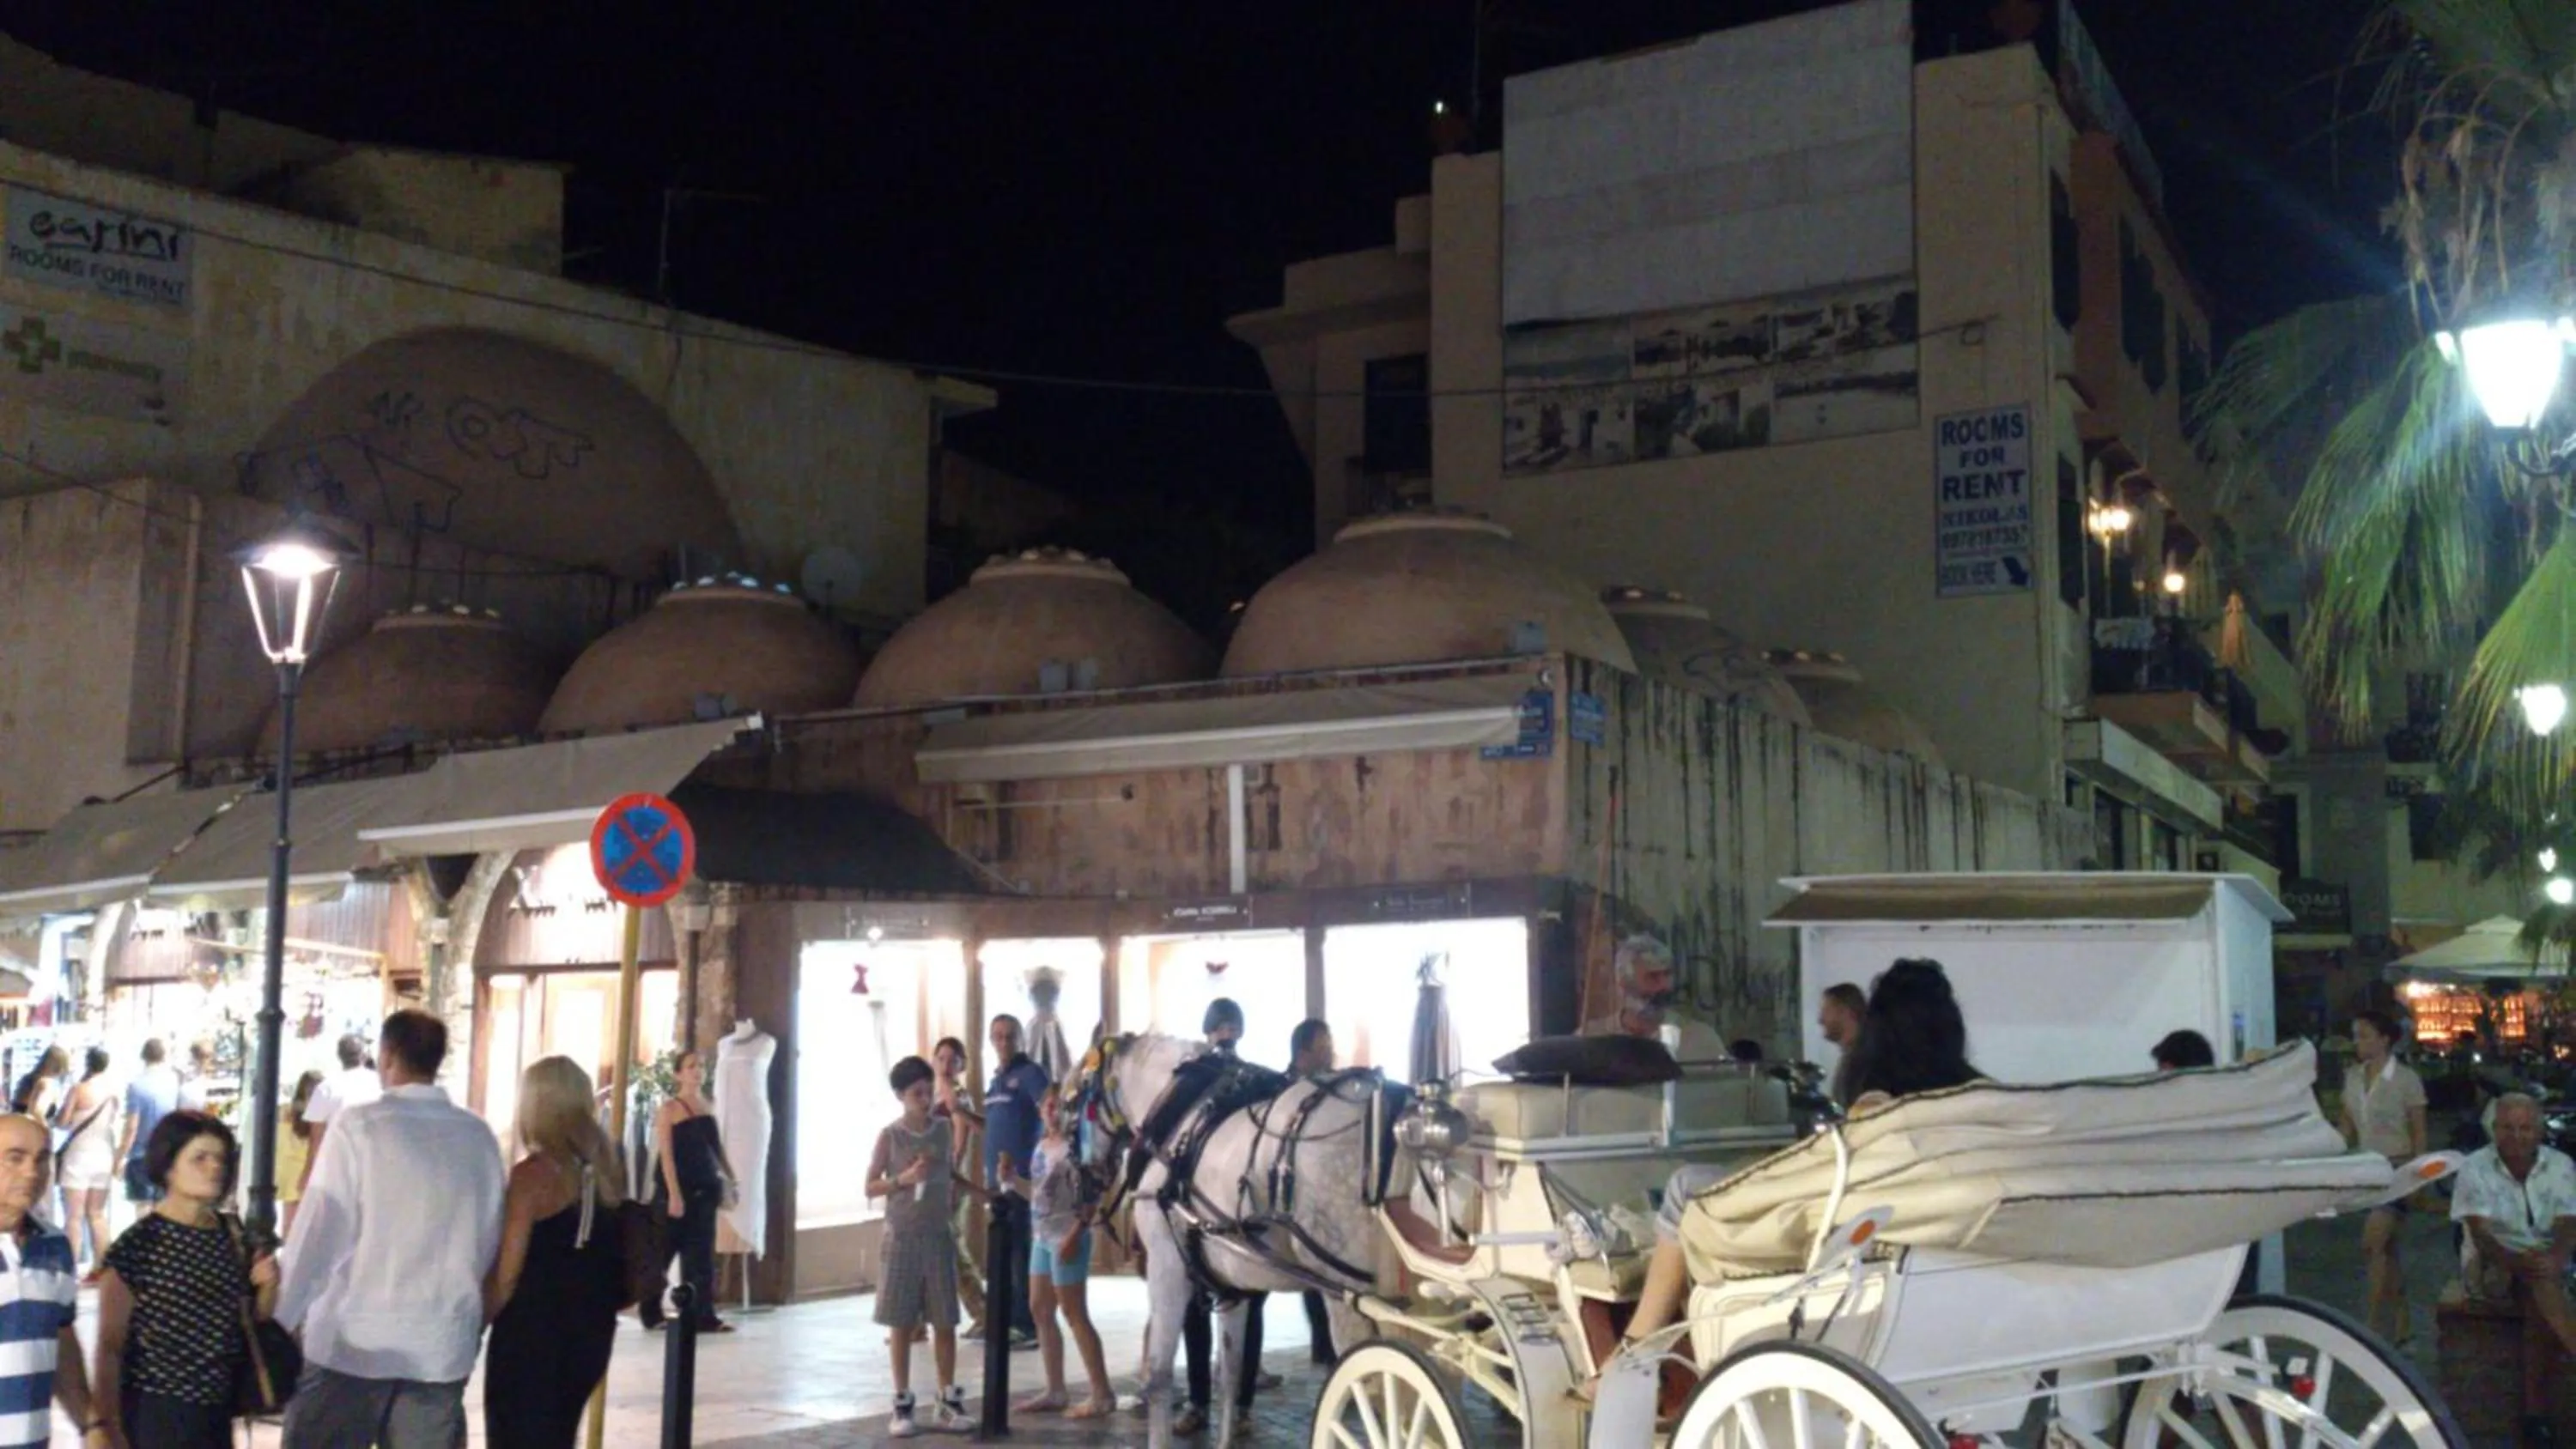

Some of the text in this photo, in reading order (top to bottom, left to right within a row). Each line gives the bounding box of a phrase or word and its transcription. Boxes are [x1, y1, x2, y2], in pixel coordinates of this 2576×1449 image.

[10, 245, 85, 276] ROOMS
[88, 262, 131, 284] FOR
[135, 272, 185, 296] RENT
[1941, 412, 2025, 446] ROOMS
[1959, 446, 2005, 469] FOR
[1942, 470, 2026, 503] RENT
